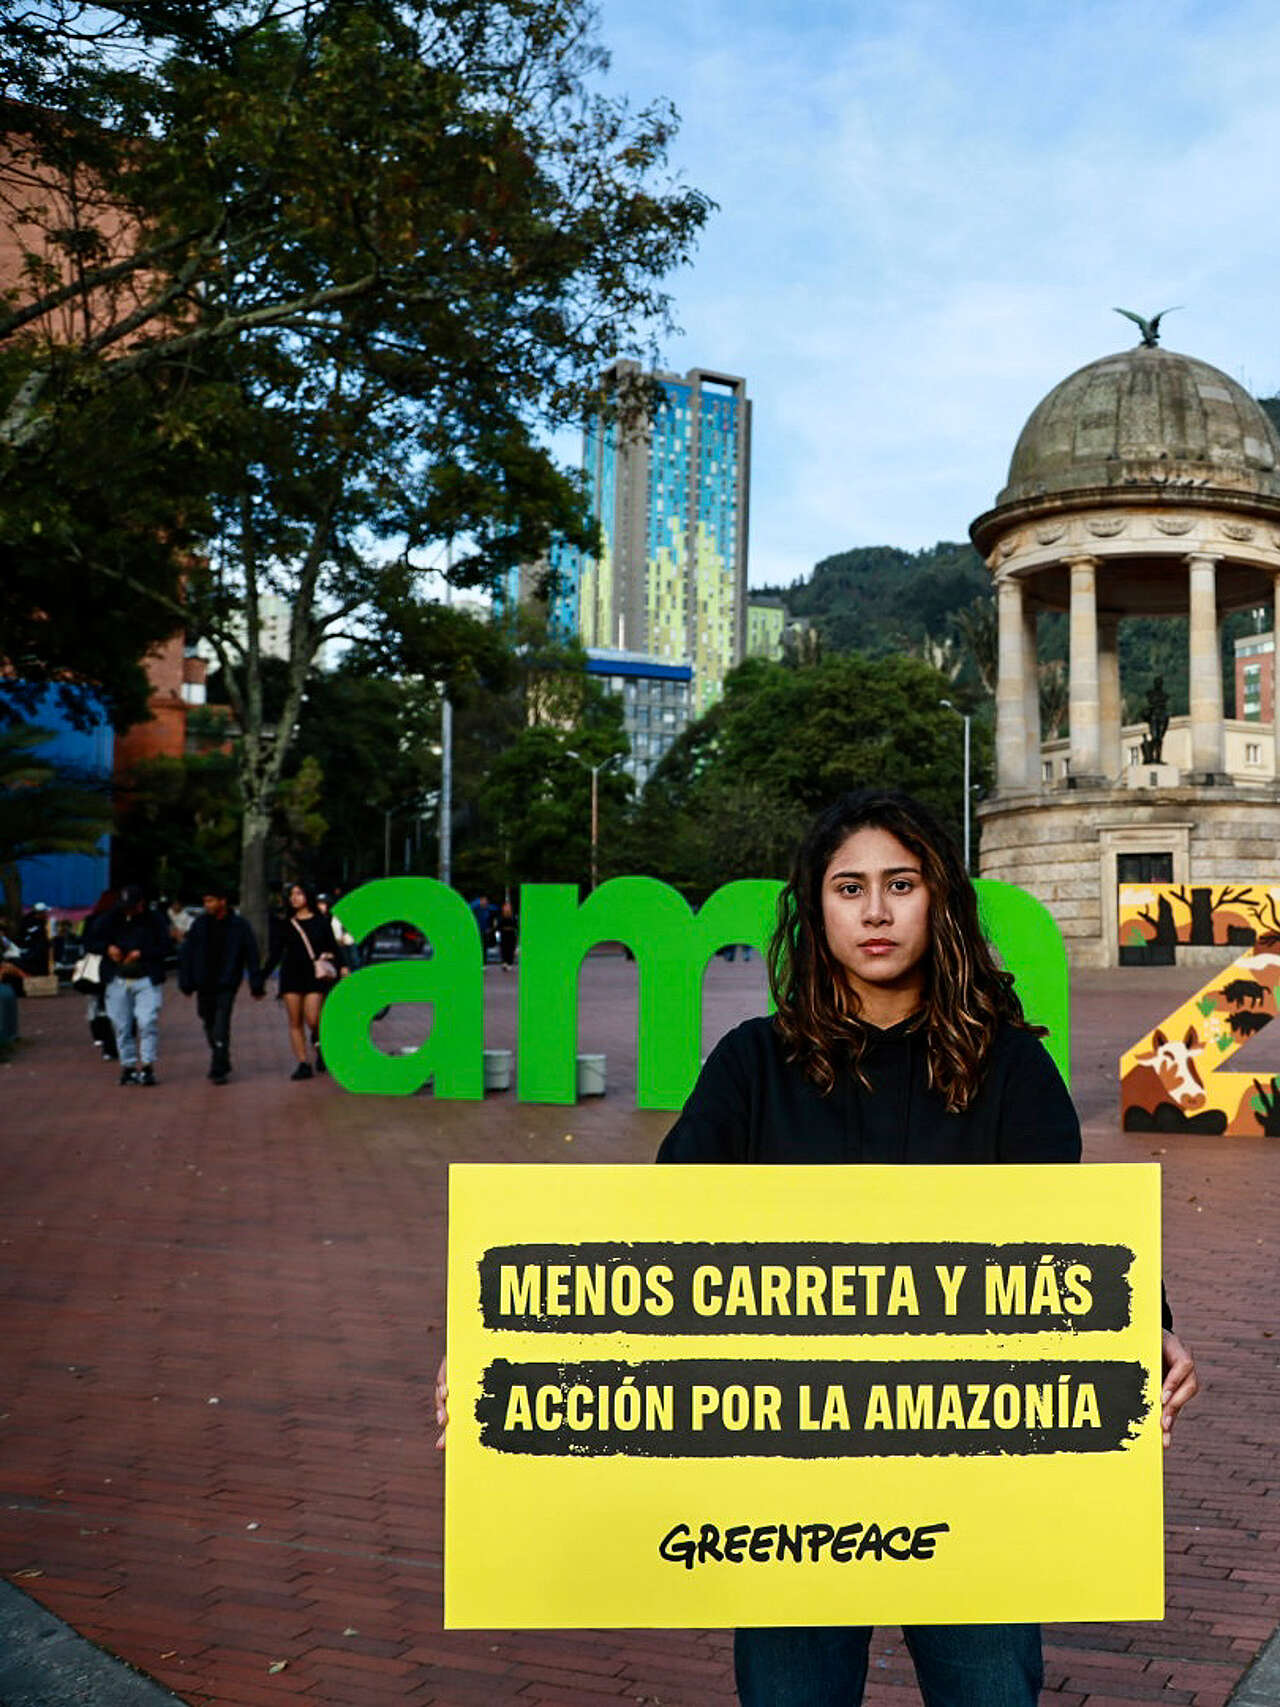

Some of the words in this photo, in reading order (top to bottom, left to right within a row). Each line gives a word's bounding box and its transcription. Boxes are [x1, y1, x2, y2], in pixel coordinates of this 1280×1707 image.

[499, 1263, 675, 1318] MENOS
[692, 1263, 920, 1318] CARRETA
[935, 1264, 968, 1317] Y
[984, 1254, 1094, 1317] MÁS
[503, 1375, 674, 1432] ACCIÓN
[691, 1384, 783, 1432] POR
[799, 1384, 851, 1431] LA
[863, 1373, 1102, 1431] AMAZONÍA
[658, 1521, 951, 1571] GREENPEACE
